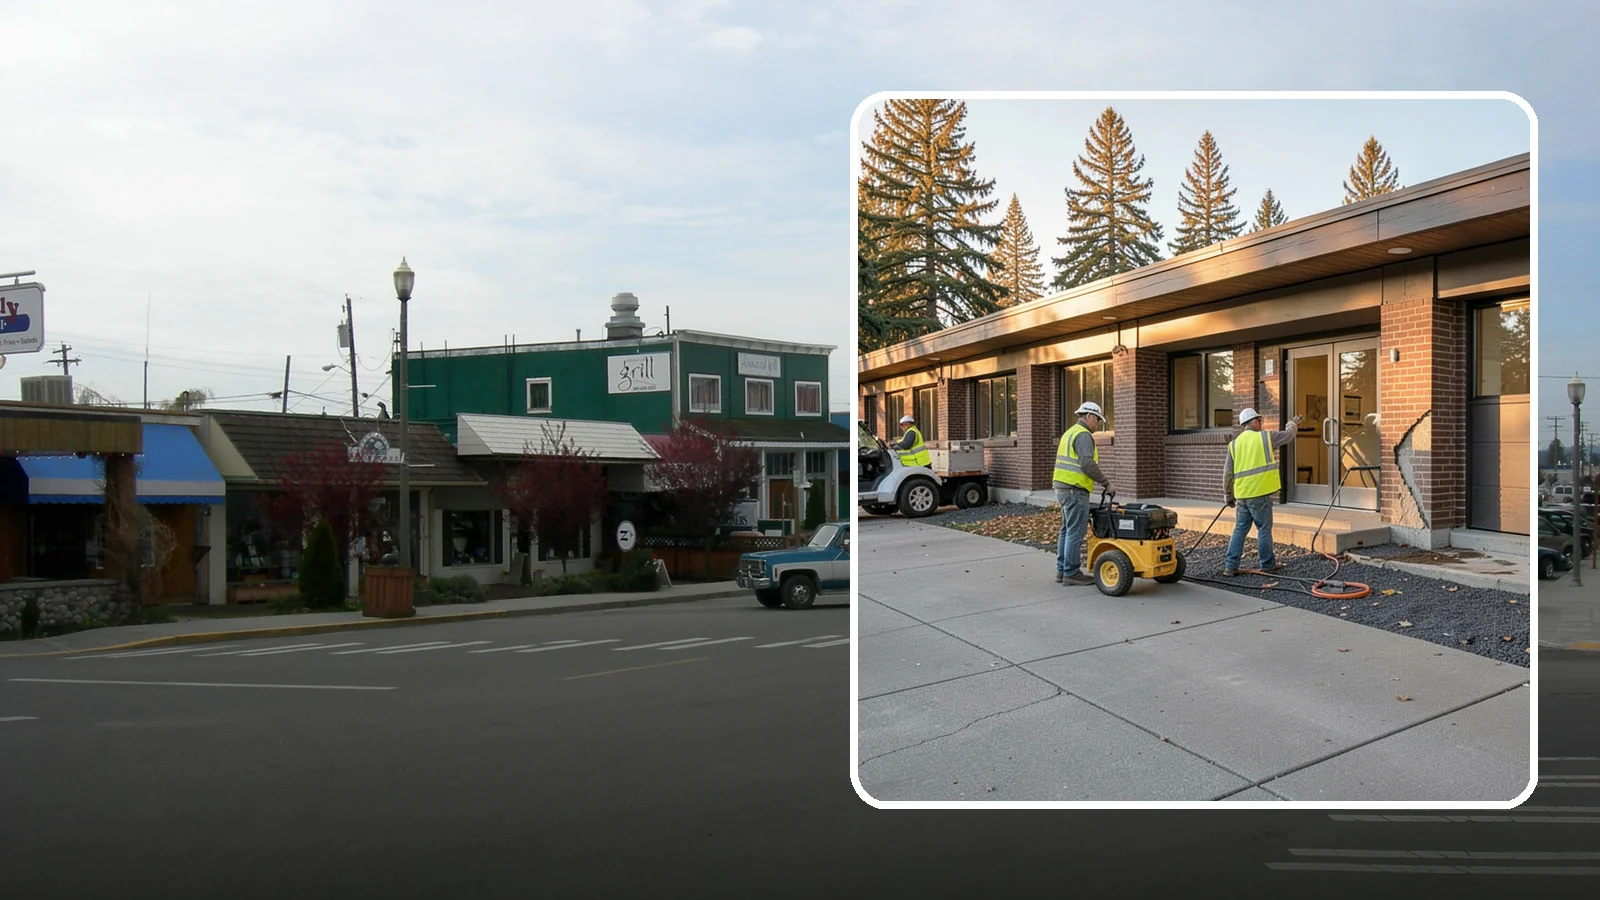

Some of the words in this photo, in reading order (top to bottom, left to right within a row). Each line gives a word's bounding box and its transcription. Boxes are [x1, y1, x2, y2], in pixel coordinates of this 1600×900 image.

[3, 338, 15, 346] Fries
[20, 337, 38, 345] Salads
[618, 356, 654, 391] grill
